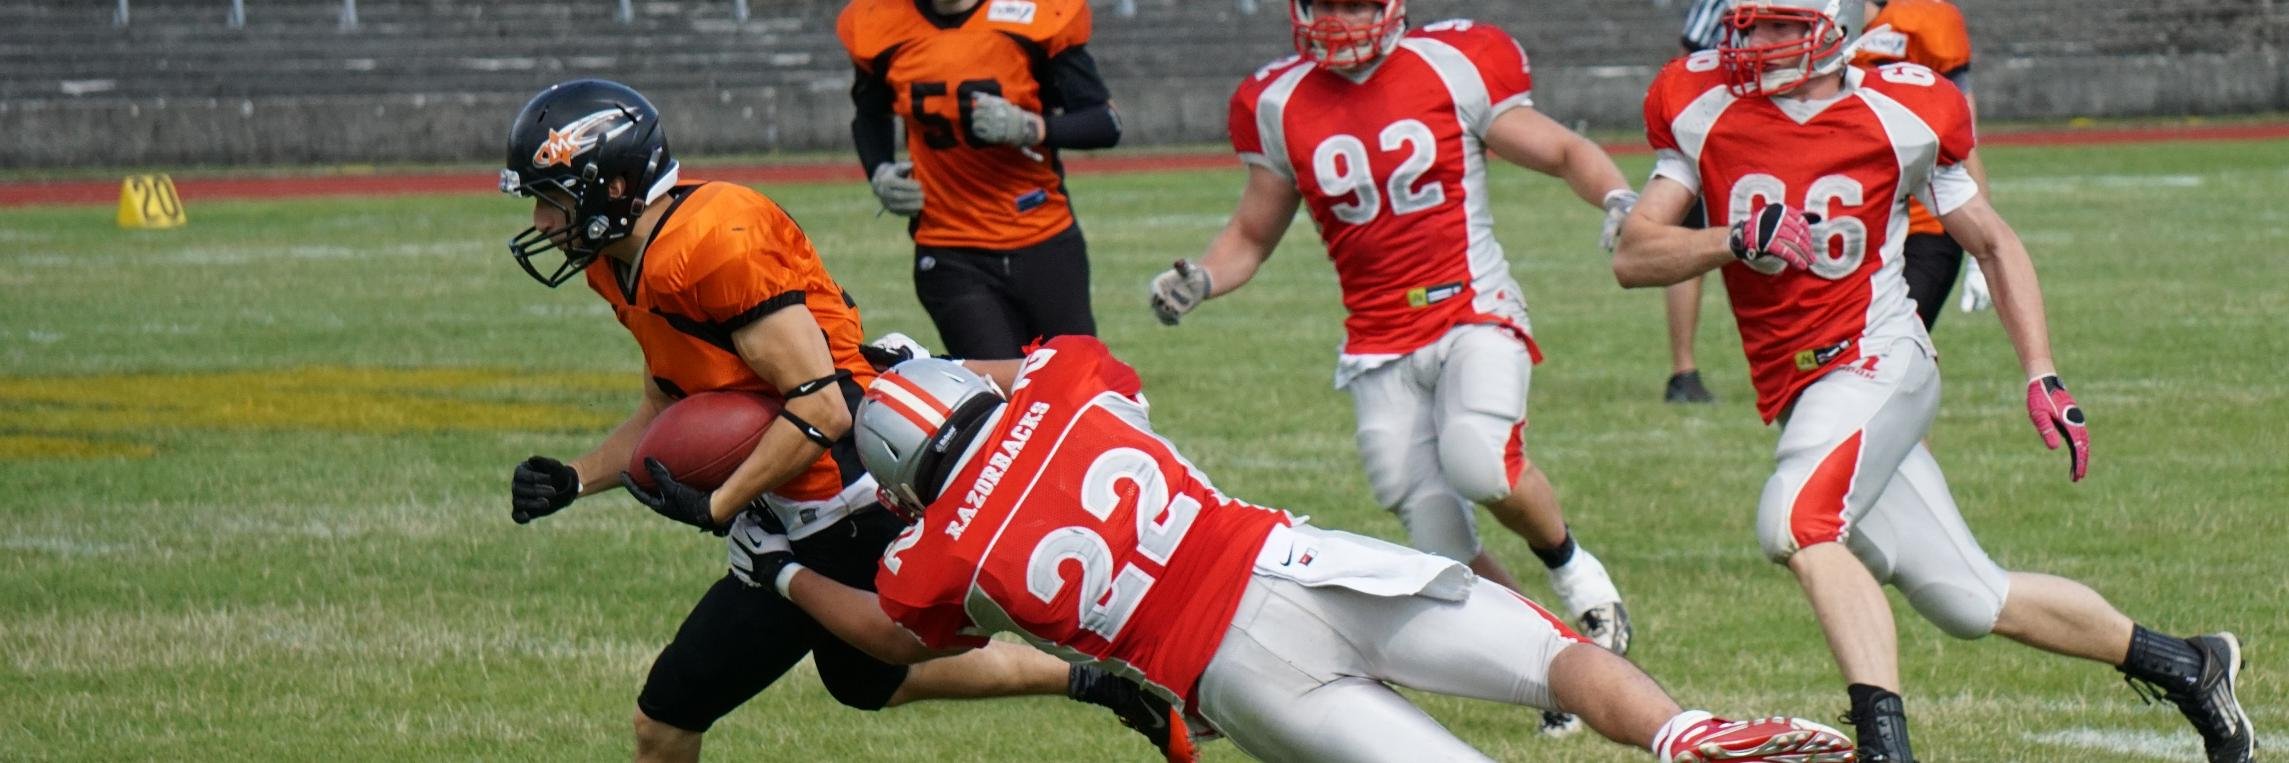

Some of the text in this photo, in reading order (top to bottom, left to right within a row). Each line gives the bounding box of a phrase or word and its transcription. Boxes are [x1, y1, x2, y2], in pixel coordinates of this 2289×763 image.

[132, 175, 178, 222] 20
[1313, 118, 1446, 225] 92
[1728, 173, 1867, 280] 66
[944, 401, 1051, 541] RAZORBACKS
[1026, 447, 1203, 643] 22
